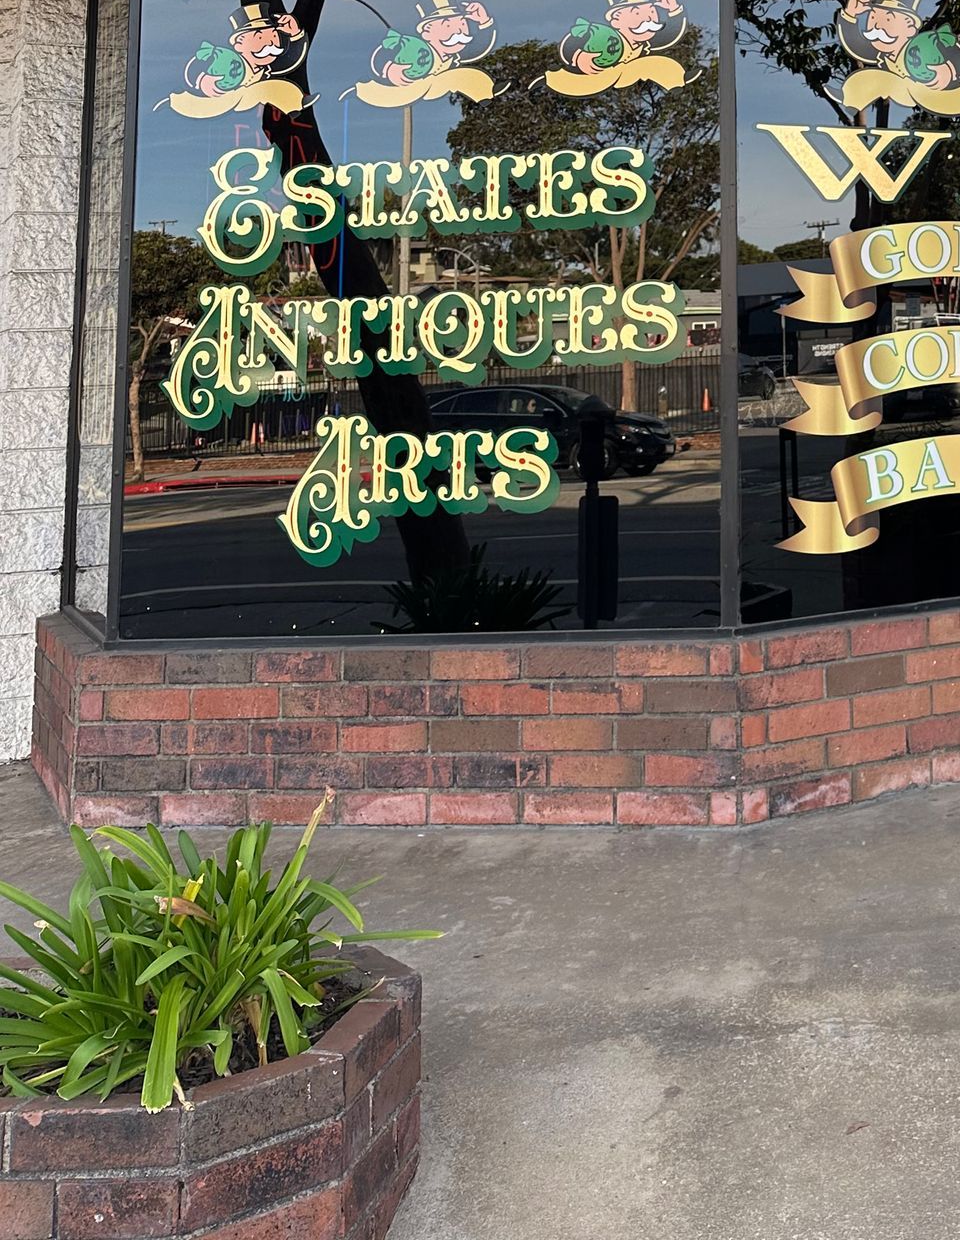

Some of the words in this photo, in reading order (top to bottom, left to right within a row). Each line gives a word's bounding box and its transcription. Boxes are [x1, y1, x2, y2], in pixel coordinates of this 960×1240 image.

[197, 145, 650, 268] ESTATES
[162, 281, 680, 420] ANTIQUES
[277, 415, 551, 555] ARTS
